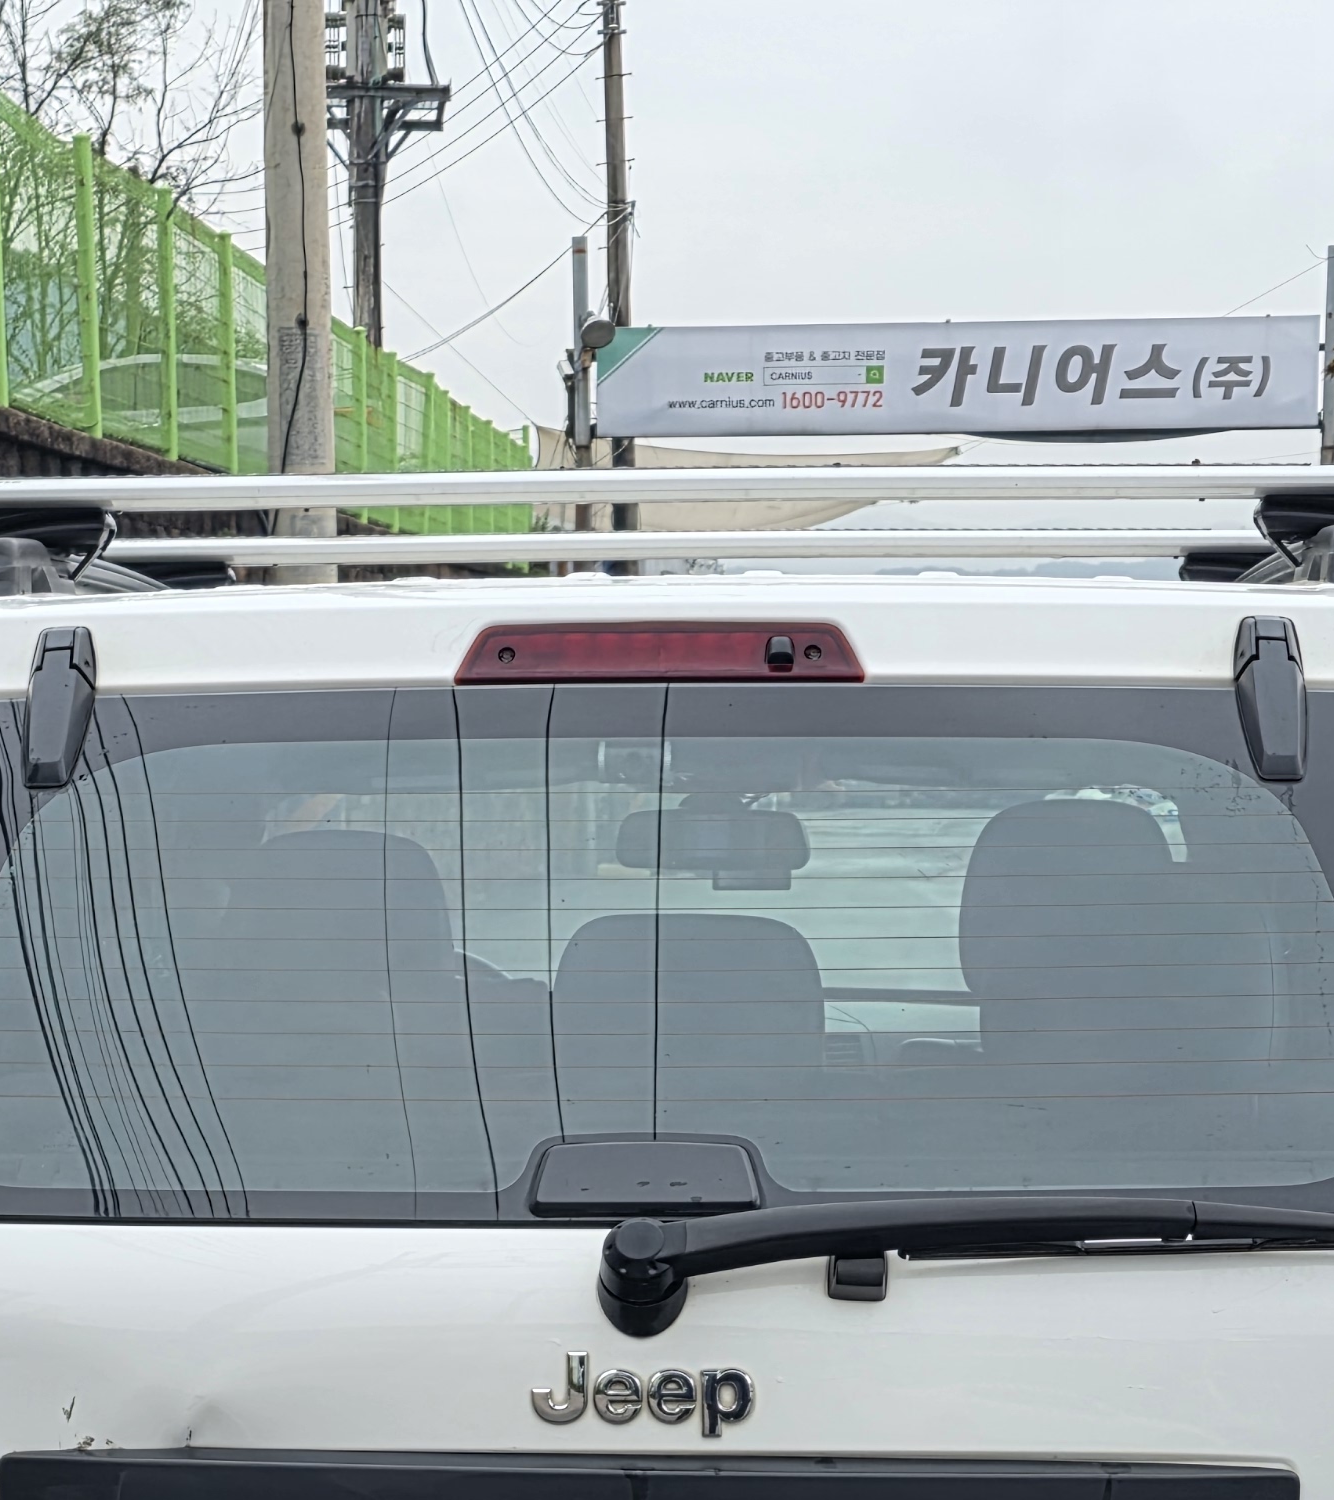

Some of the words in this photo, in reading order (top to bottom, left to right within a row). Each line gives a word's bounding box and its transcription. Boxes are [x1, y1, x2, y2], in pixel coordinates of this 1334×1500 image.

[808, 351, 816, 361] &
[704, 372, 754, 382] NAVER
[770, 371, 813, 381] CARNIUS
[668, 397, 775, 409] www.carnius.com
[782, 390, 883, 409] 1600-9772
[531, 1351, 756, 1438] Jeep
